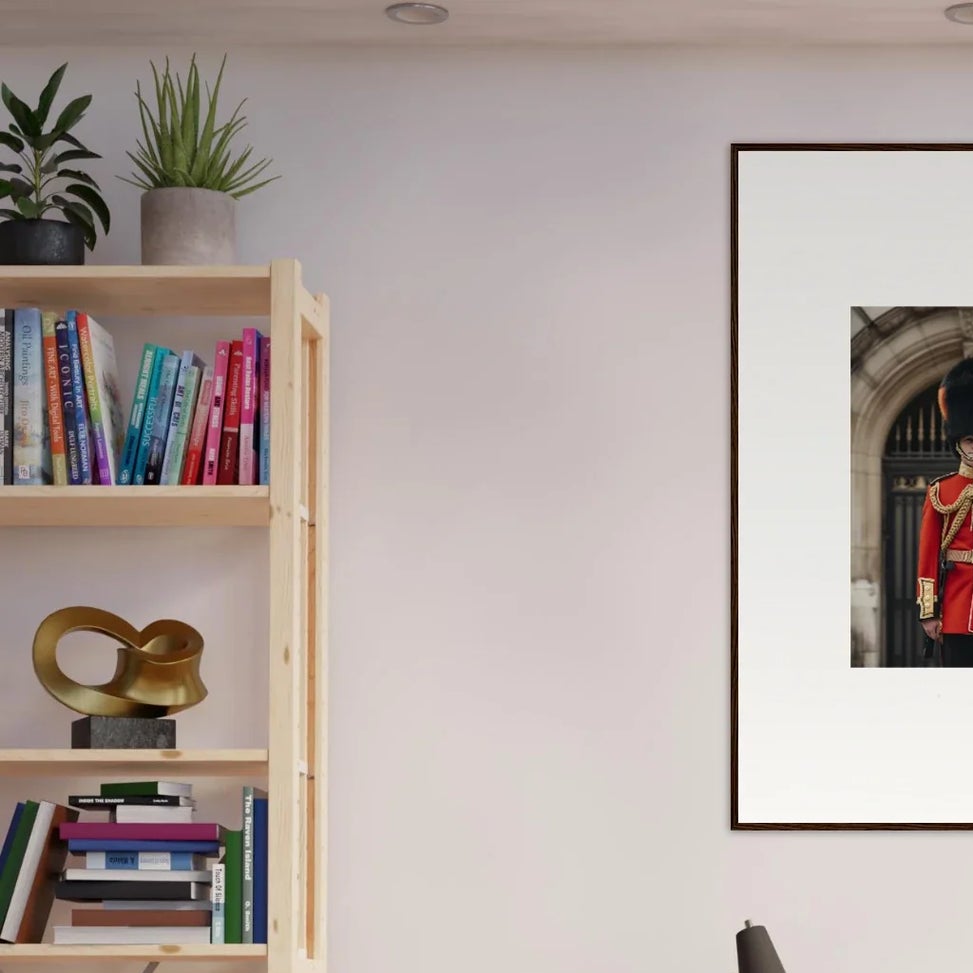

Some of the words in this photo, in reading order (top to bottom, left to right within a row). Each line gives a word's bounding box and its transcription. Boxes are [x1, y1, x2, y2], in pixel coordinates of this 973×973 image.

[21, 325, 32, 339] Oil
[18, 342, 32, 386] Paintings
[47, 347, 57, 364] FINE
[79, 326, 93, 374] Watercolor
[87, 375, 98, 412] Portraits
[49, 364, 57, 379] ART
[59, 344, 73, 409] ICONIC
[230, 363, 241, 396] Parenting
[50, 403, 61, 425] Digital
[229, 397, 238, 416] Skills
[244, 794, 252, 814] The
[244, 816, 252, 848] Raven
[244, 849, 252, 881] Island
